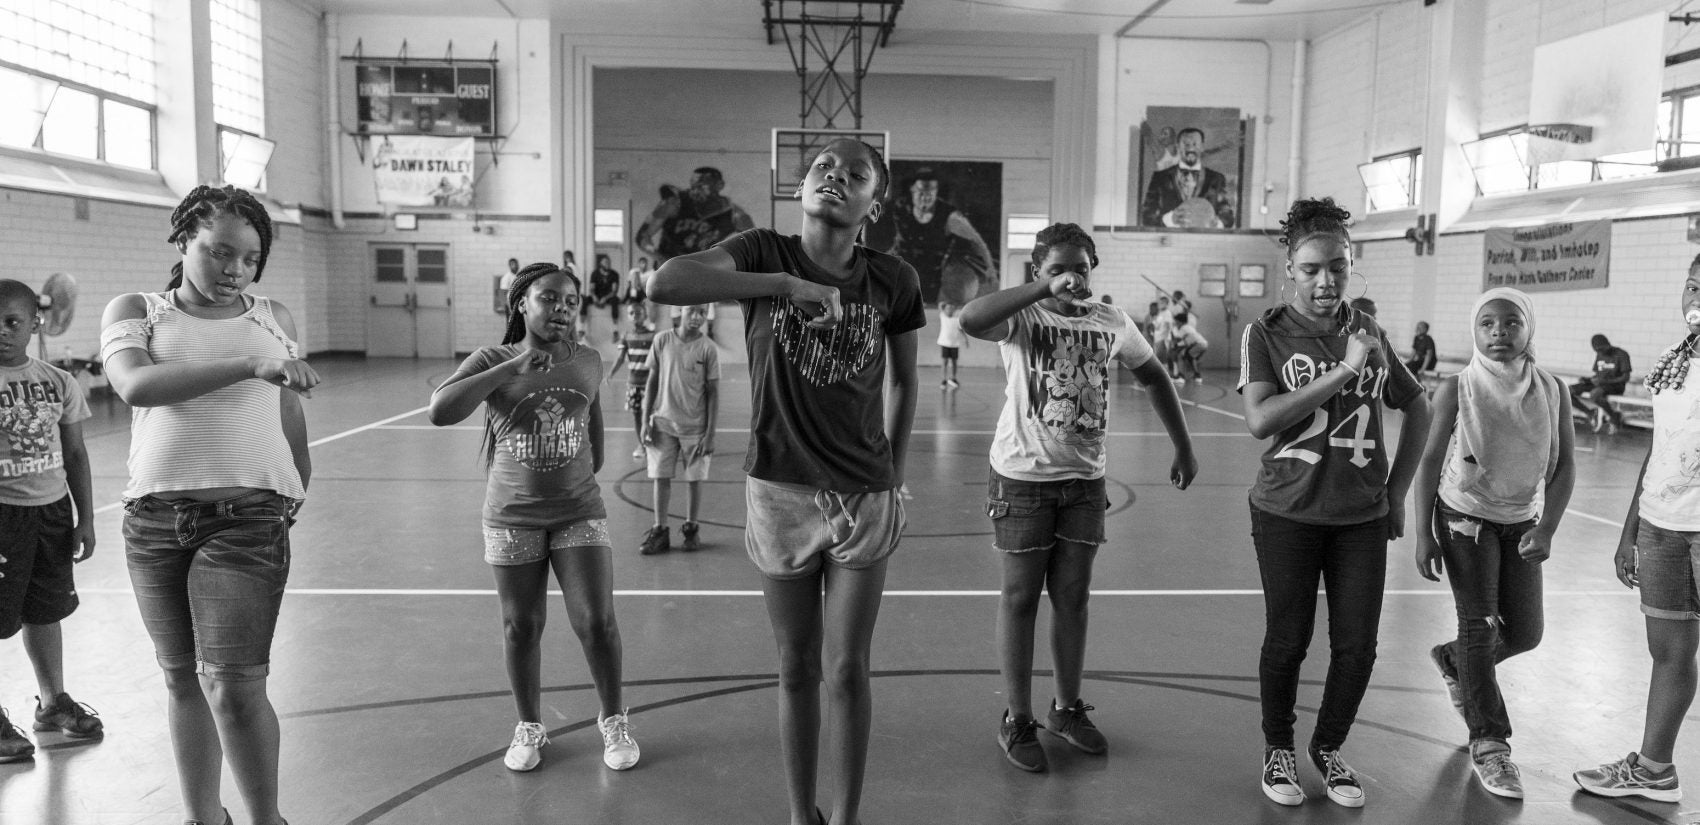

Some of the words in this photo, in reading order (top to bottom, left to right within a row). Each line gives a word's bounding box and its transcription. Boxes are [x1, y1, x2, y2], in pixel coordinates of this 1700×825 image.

[458, 84, 489, 99] GUEST
[391, 159, 424, 172] DAWN
[427, 159, 472, 173] STALEY
[1541, 245, 1557, 262] and
[1569, 266, 1596, 282] Center
[0, 381, 62, 408] OUGH
[557, 417, 575, 435] AM
[1274, 404, 1376, 468] 24
[516, 433, 579, 459] HUMAN
[0, 452, 63, 477] TURTLE
